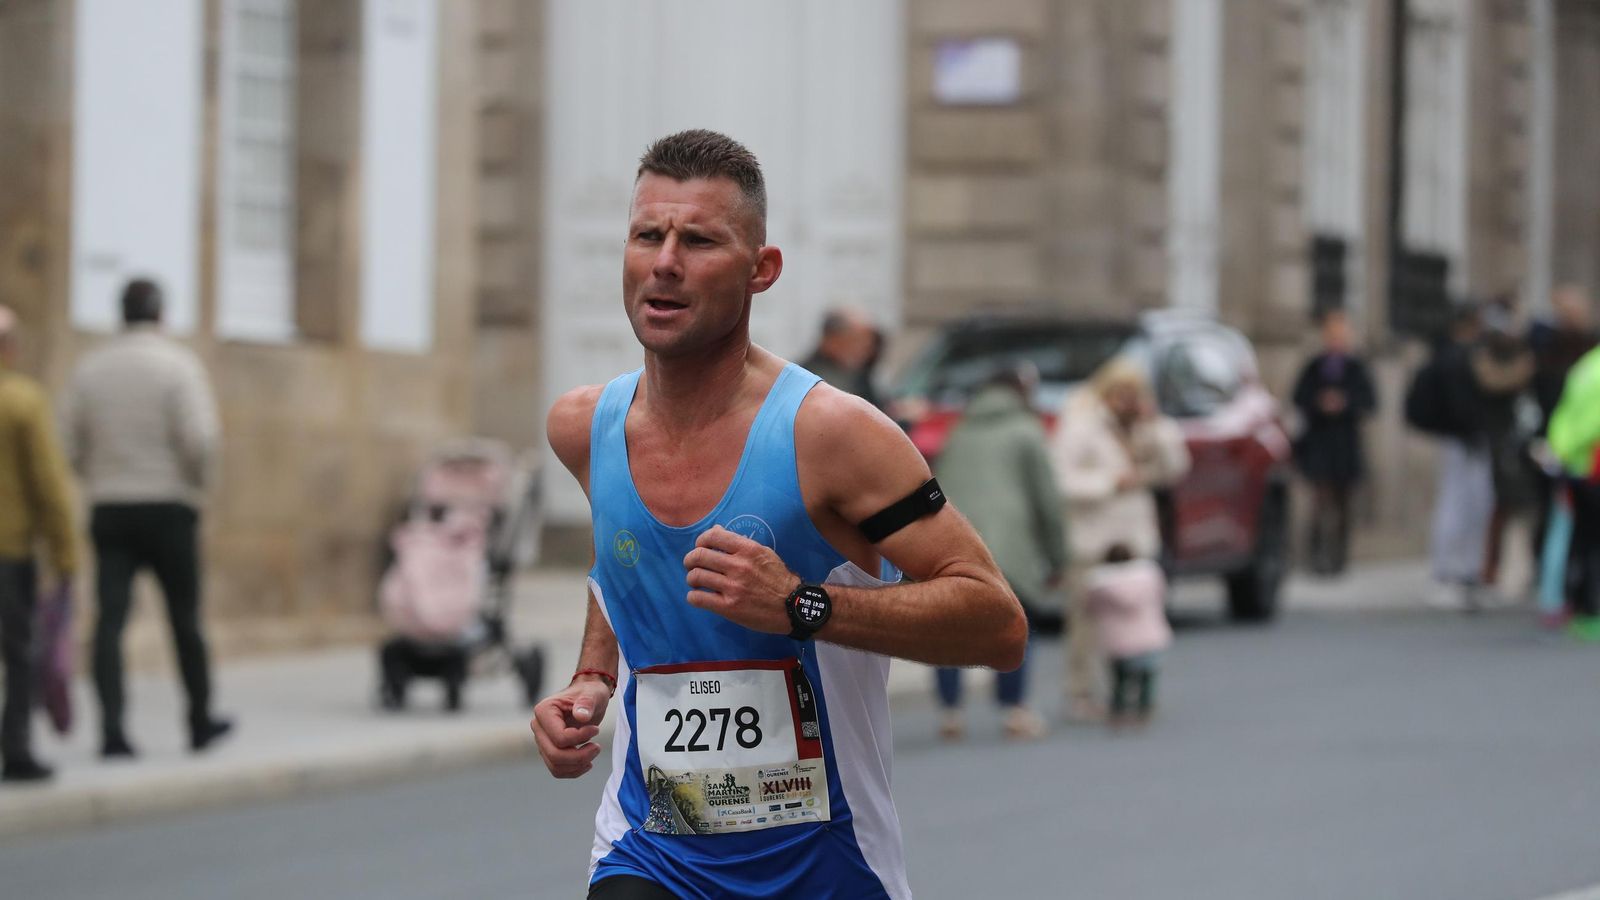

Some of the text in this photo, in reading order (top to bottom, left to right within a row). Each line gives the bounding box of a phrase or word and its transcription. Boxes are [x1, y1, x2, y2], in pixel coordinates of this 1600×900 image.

[690, 680, 721, 694] ELISEO
[664, 706, 763, 752] 2278
[763, 777, 811, 795] XLVIII
[708, 798, 751, 806] OURENSE
